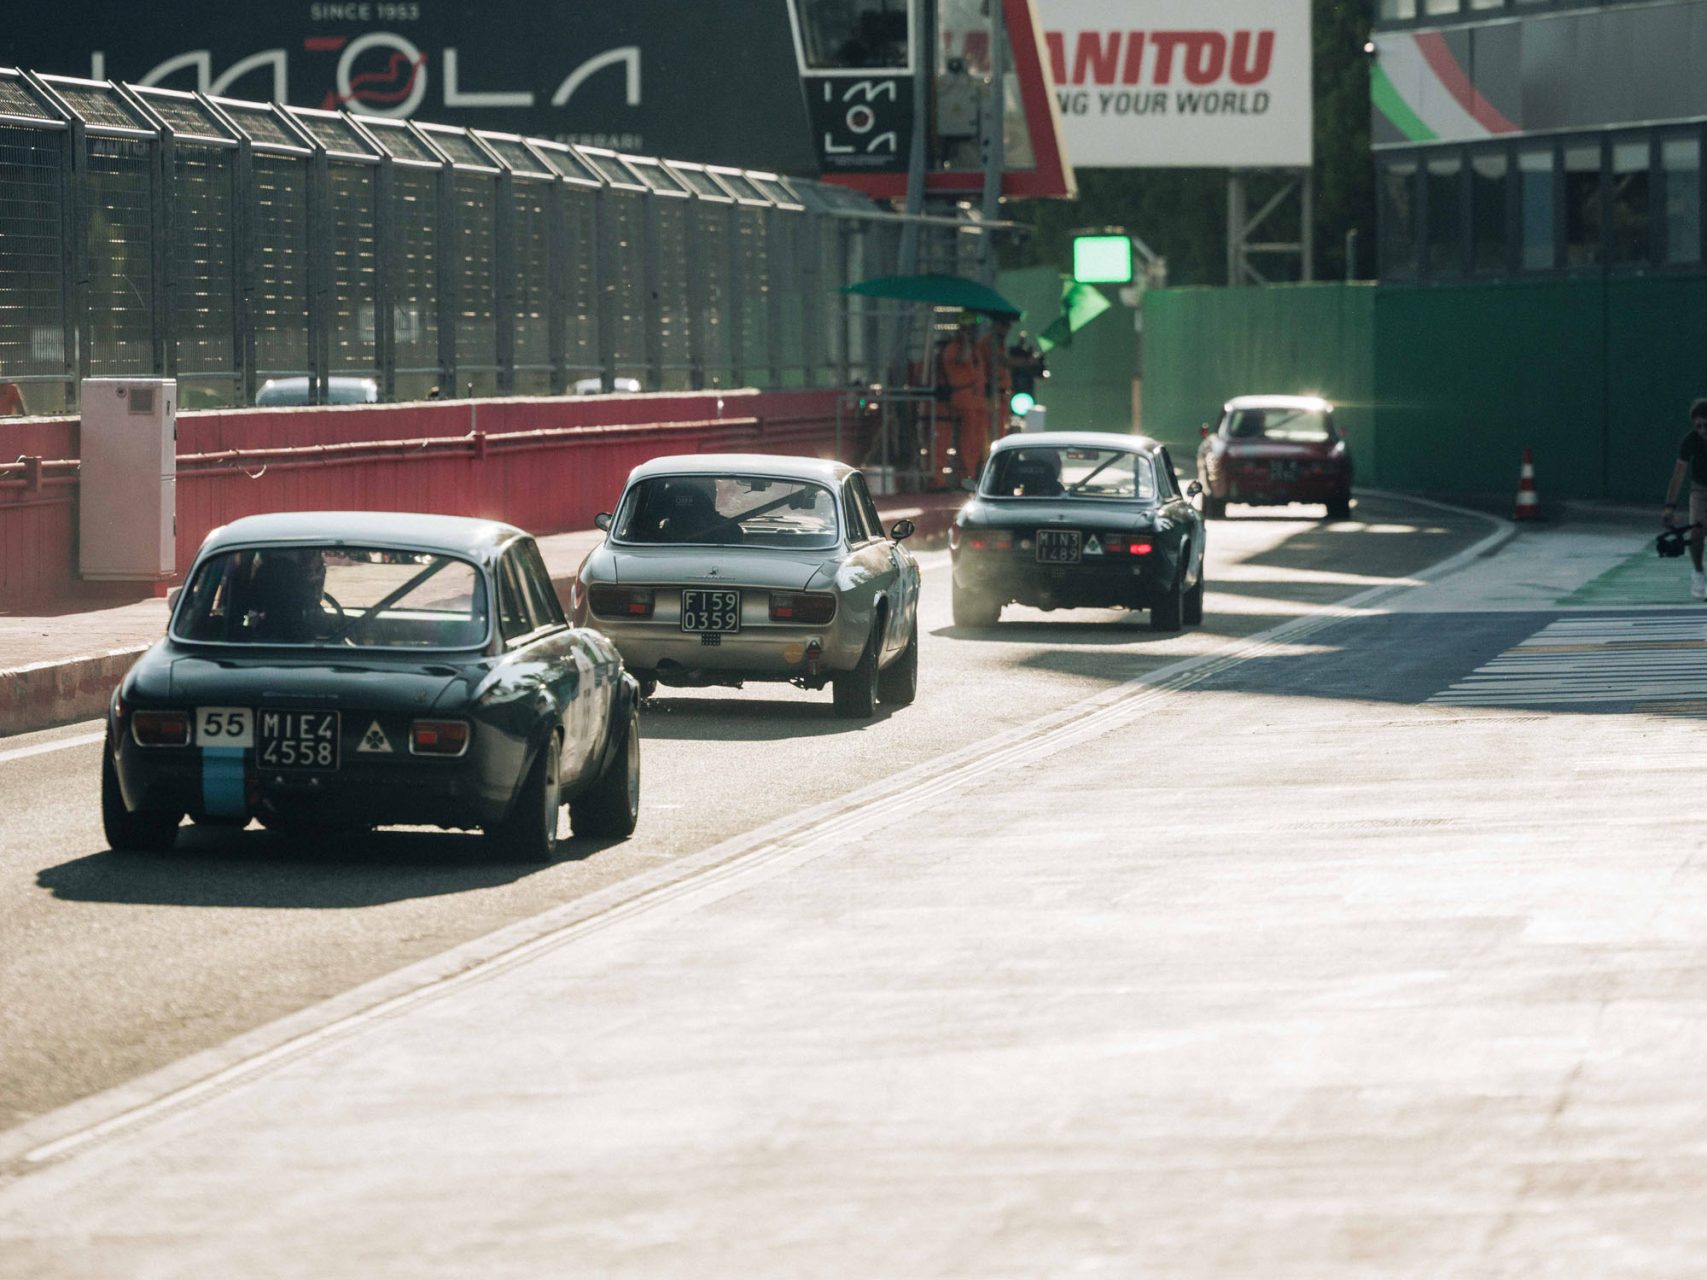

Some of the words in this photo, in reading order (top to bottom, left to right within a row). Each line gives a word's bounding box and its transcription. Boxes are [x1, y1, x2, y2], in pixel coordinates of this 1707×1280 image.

[310, 2, 372, 21] SINCE
[378, 2, 420, 21] 1953
[1099, 91, 1167, 116] YOUR
[1176, 90, 1270, 116] WORLD
[685, 611, 736, 630] 0359
[203, 712, 245, 737] 55
[263, 713, 333, 739] MIE4
[263, 740, 332, 765] 4558
